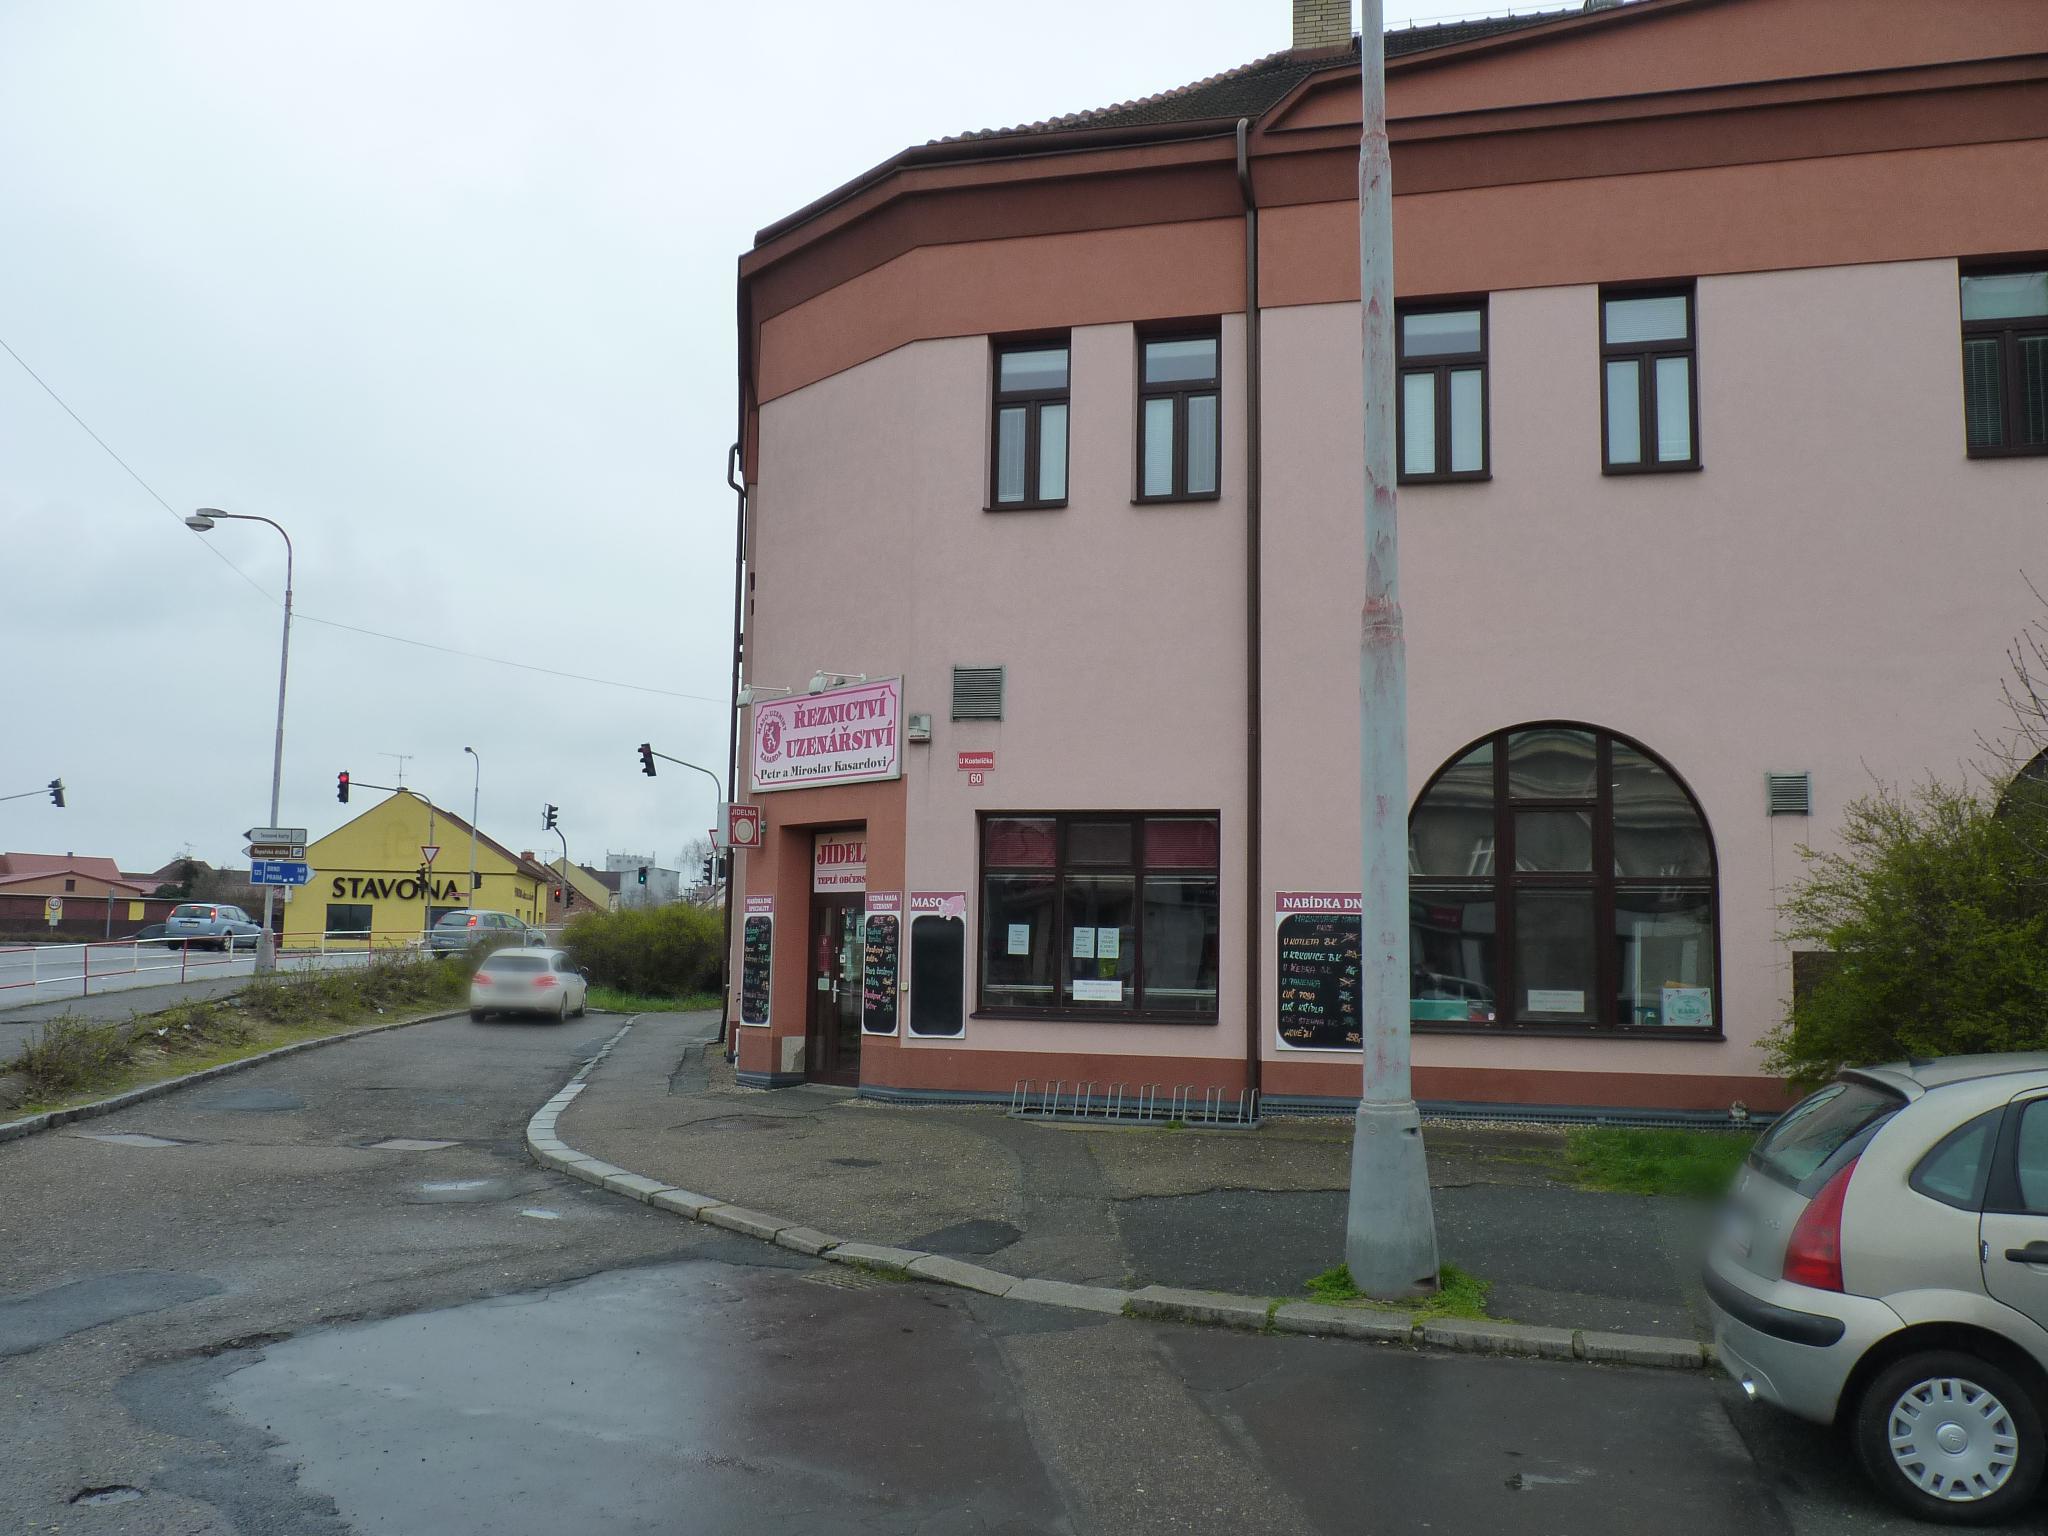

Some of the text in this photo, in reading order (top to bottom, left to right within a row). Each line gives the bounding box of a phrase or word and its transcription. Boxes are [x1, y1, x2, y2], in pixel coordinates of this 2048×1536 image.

[793, 690, 887, 729] ŘEZNICTVÍ
[786, 720, 894, 758] UZENÁŘSTVÍ
[760, 756, 887, 780] Petr a Miroslav Kasardovi
[970, 773, 982, 783] 60
[816, 836, 866, 865] JÍDEL
[332, 877, 461, 901] STAVONA
[911, 897, 944, 907] MASO
[1283, 896, 1341, 909] NABÍDKA
